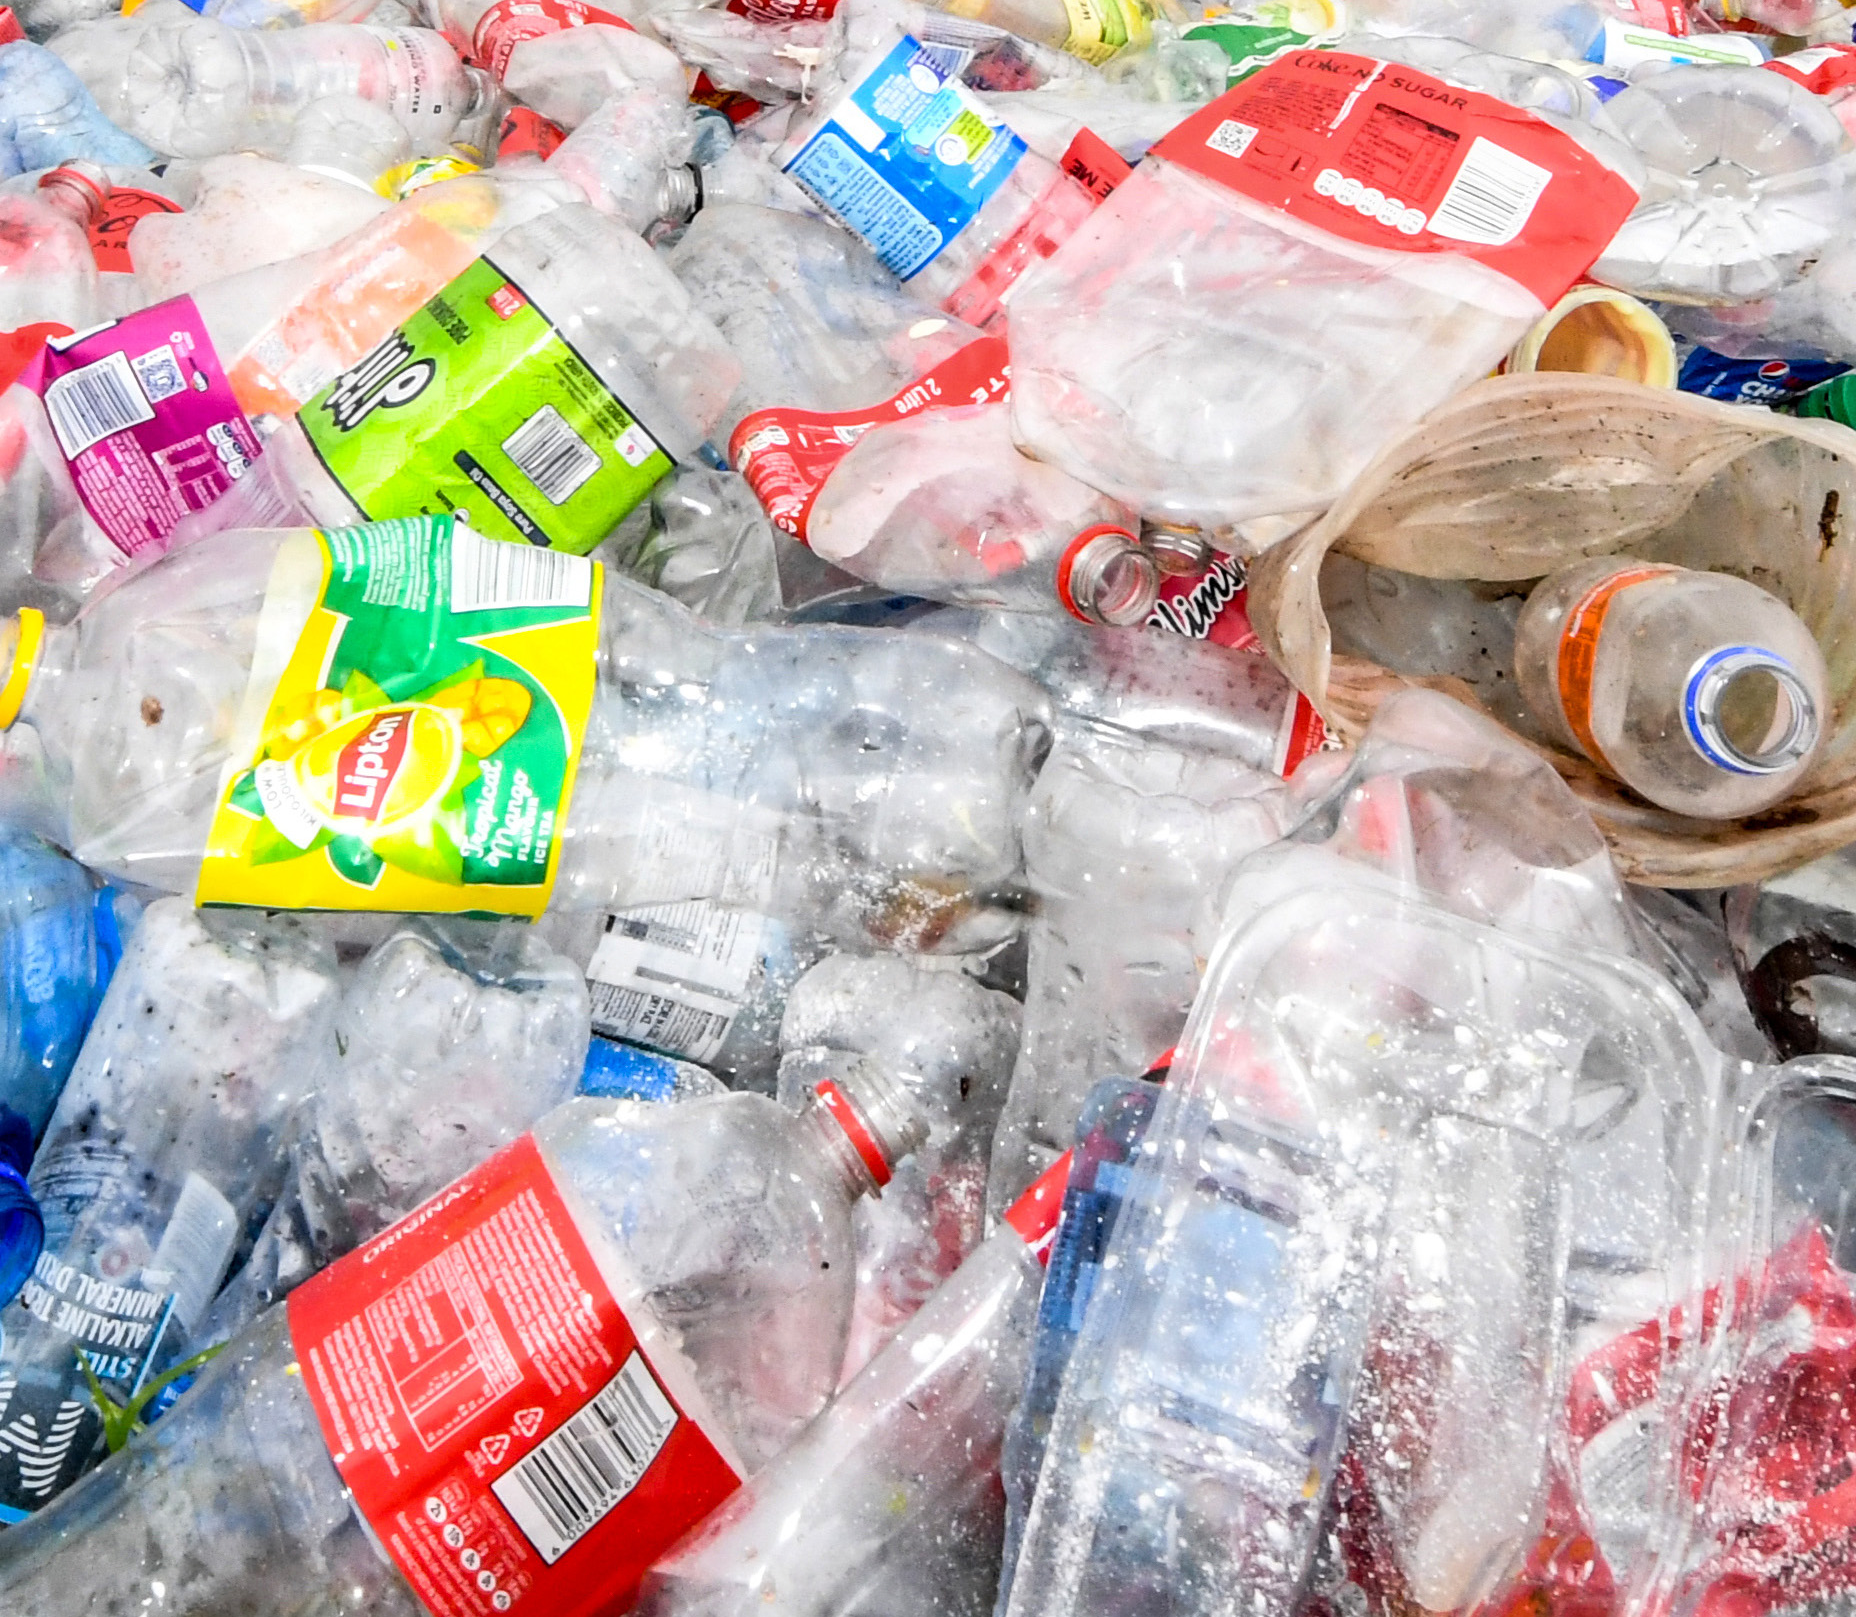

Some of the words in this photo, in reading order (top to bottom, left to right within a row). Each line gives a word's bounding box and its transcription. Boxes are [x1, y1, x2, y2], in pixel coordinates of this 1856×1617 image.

[1389, 77, 1469, 111] SUGAR
[894, 384, 934, 414] Litre
[925, 377, 942, 397] 2
[495, 492, 520, 517] Soya
[512, 510, 535, 534] Pure
[340, 715, 404, 809] Lipton
[261, 777, 283, 812] LOW
[459, 759, 503, 858] Tropical
[483, 767, 532, 868] Mango
[537, 810, 555, 836] TEA
[533, 837, 548, 865] ICE
[362, 1182, 474, 1265] ORIGINAL
[78, 1273, 166, 1320] MINERAL
[52, 1299, 153, 1350] ALKALINE
